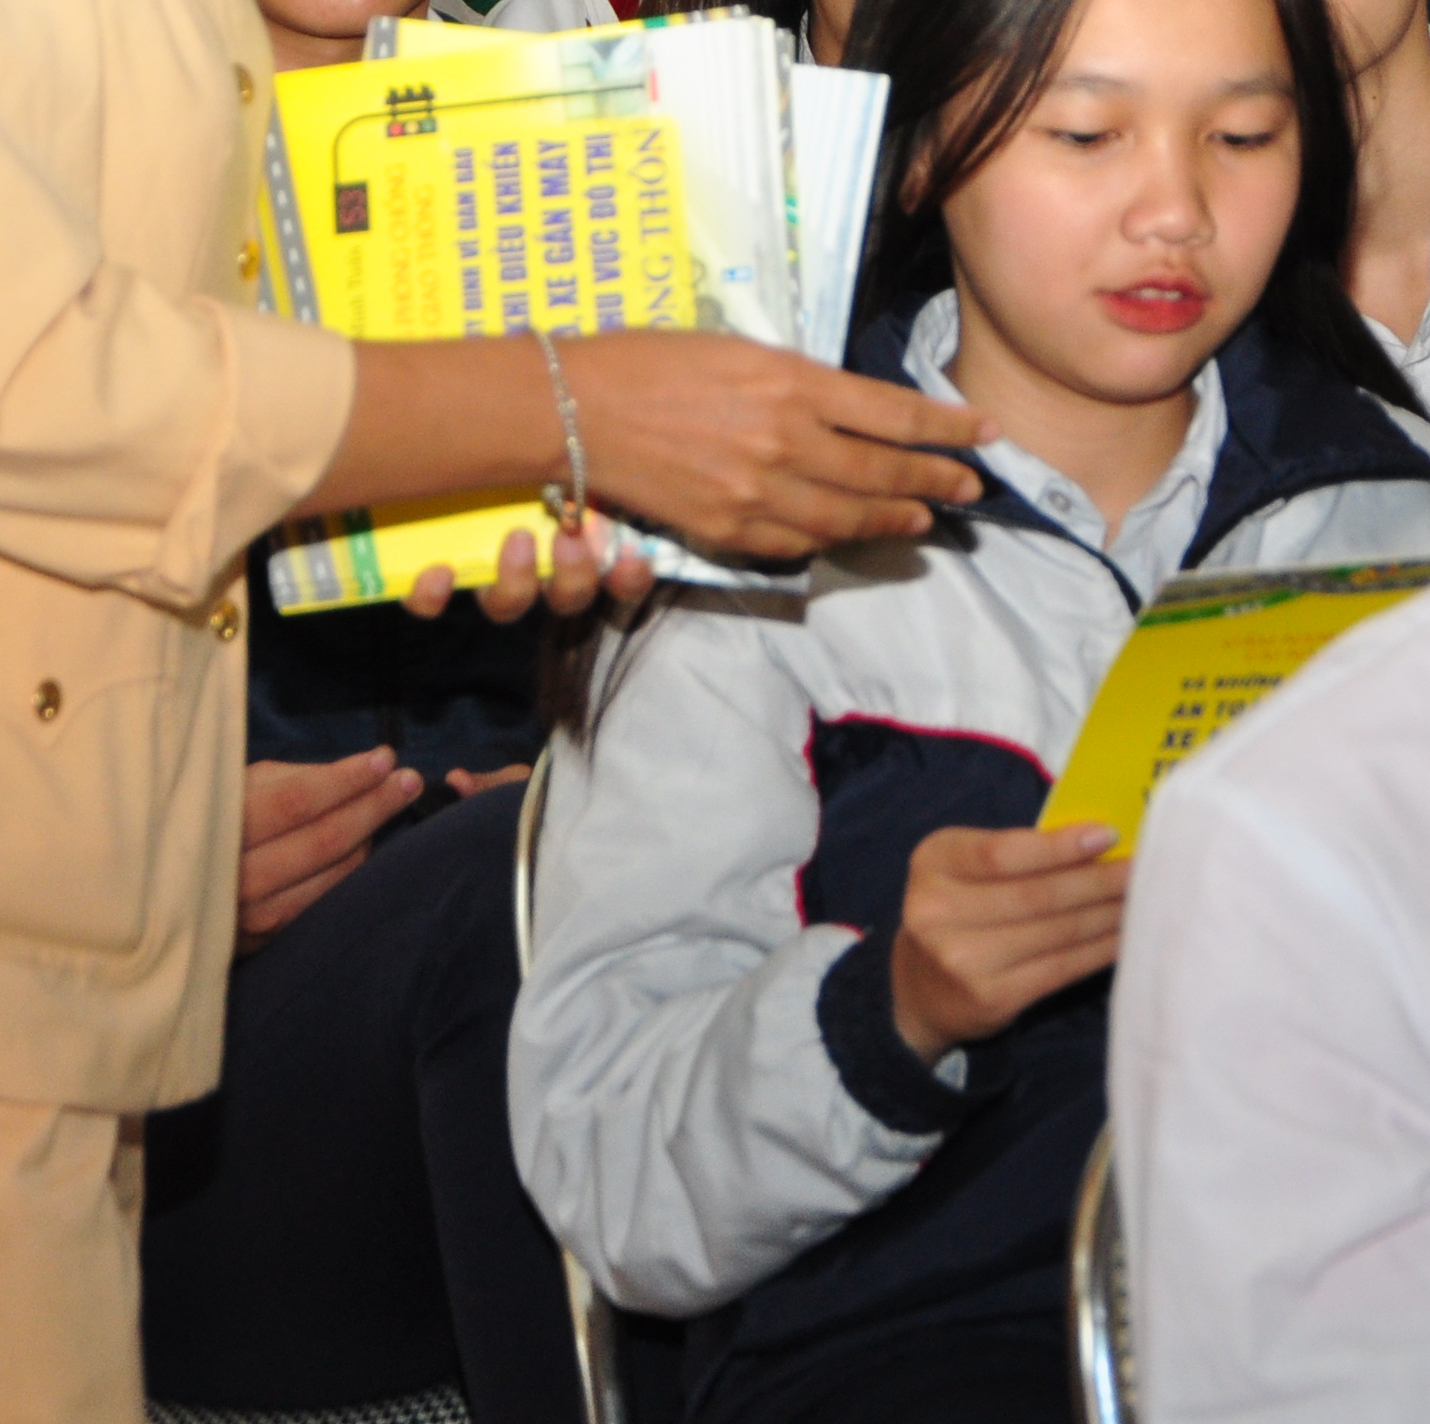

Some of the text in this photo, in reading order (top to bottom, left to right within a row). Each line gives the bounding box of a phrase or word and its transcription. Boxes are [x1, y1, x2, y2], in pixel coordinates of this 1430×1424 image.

[584, 133, 617, 175] THỊ
[628, 128, 678, 329] NG THÔN
[589, 230, 626, 283] VỰC
[419, 268, 442, 327] GIAO
[545, 275, 578, 307] XE
[595, 293, 625, 332] HU
[1172, 699, 1206, 718] AN
[1161, 727, 1197, 750] XE
